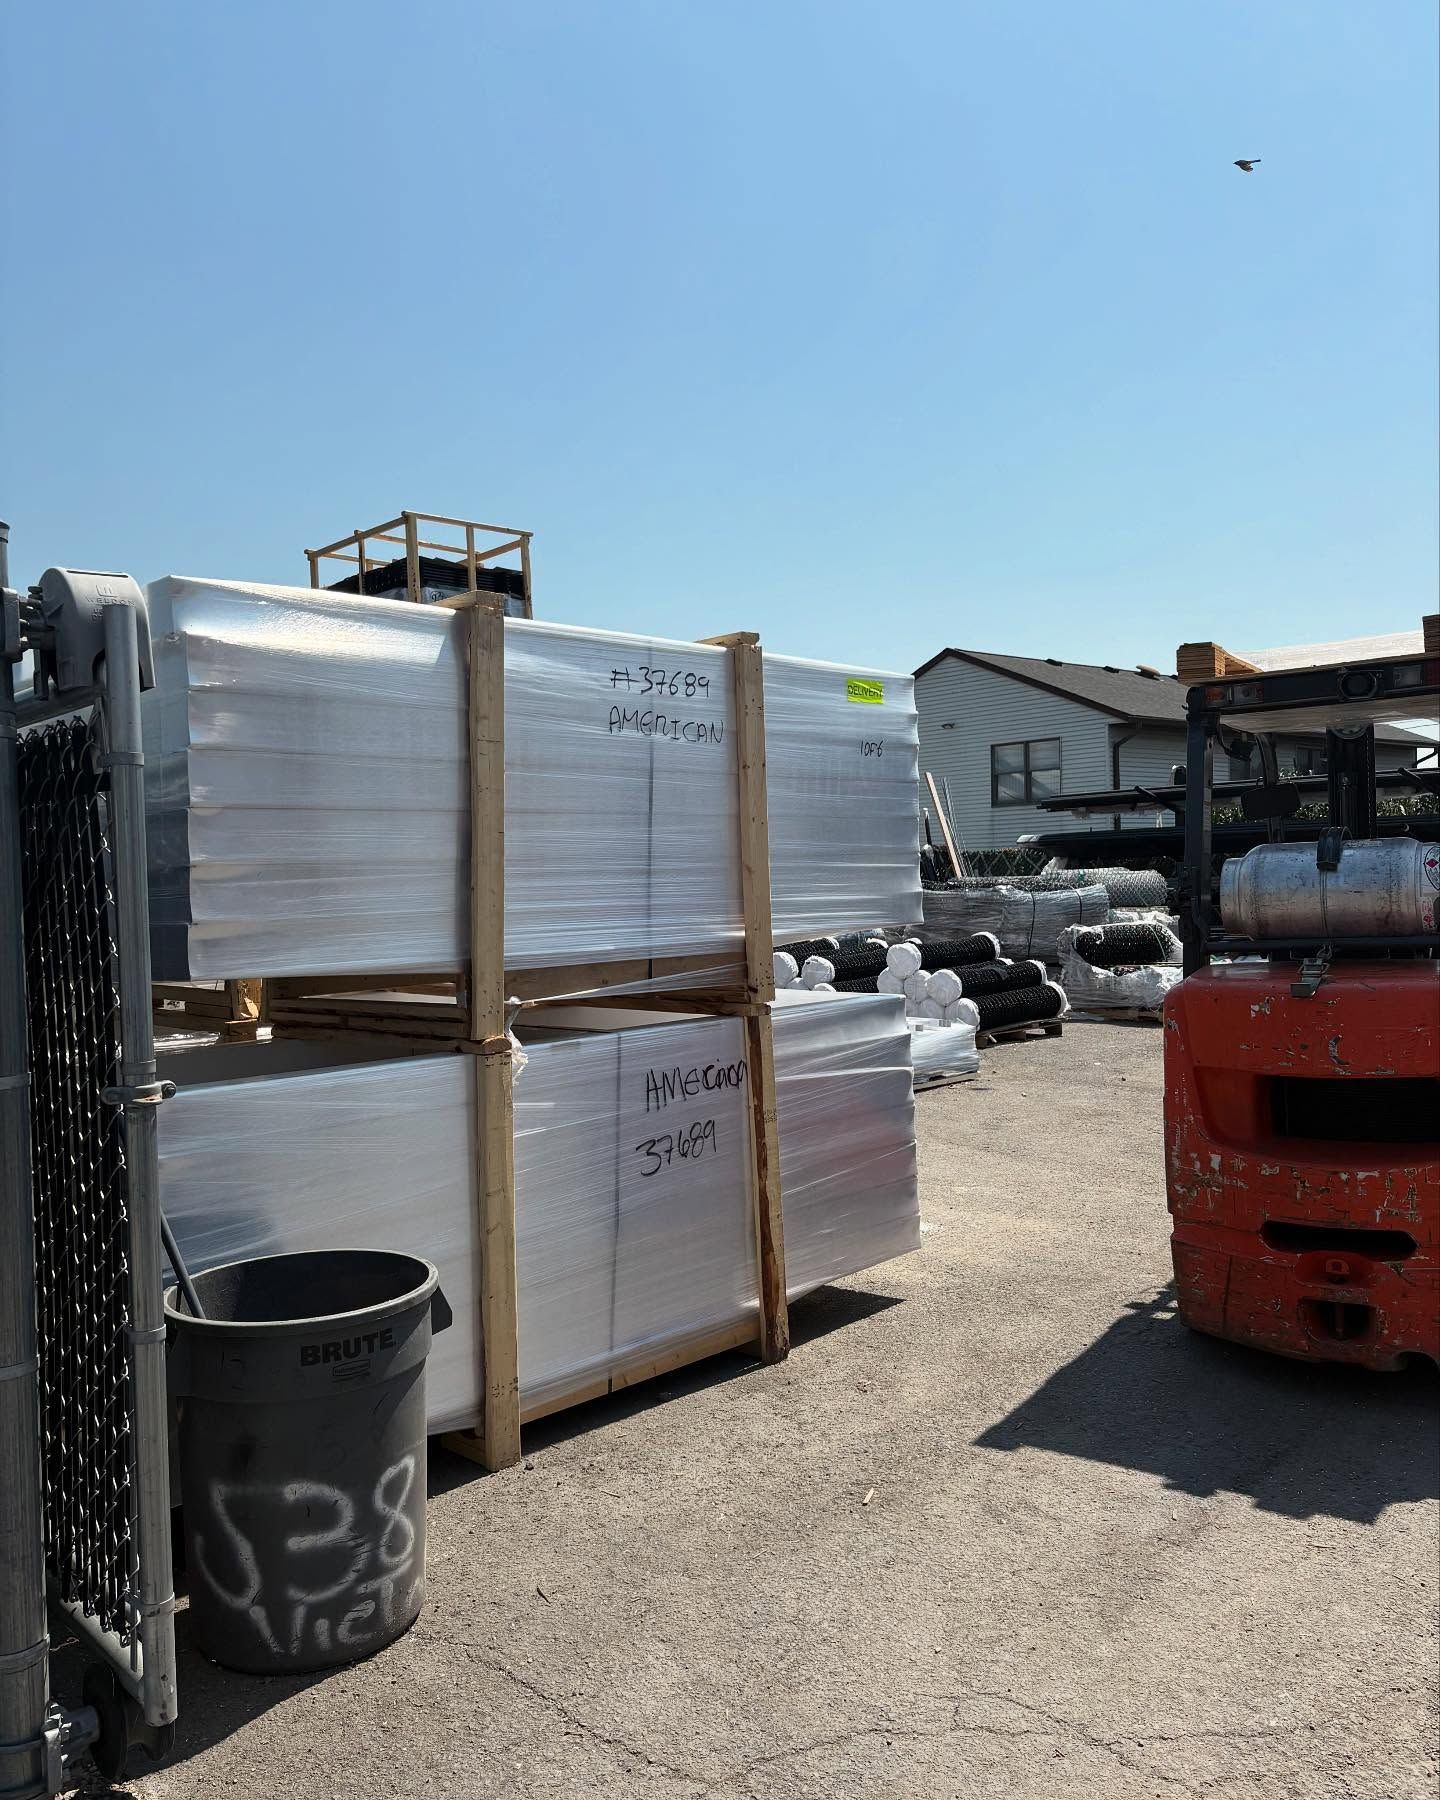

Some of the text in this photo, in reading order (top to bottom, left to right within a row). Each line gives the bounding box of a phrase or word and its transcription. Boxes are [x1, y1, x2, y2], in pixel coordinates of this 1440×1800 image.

[610, 666, 710, 697] #37689
[847, 685, 884, 697] DELIVERY
[609, 705, 724, 743] AMERICAN
[635, 1119, 717, 1176] 37689
[300, 1328, 394, 1367] BRUTE
